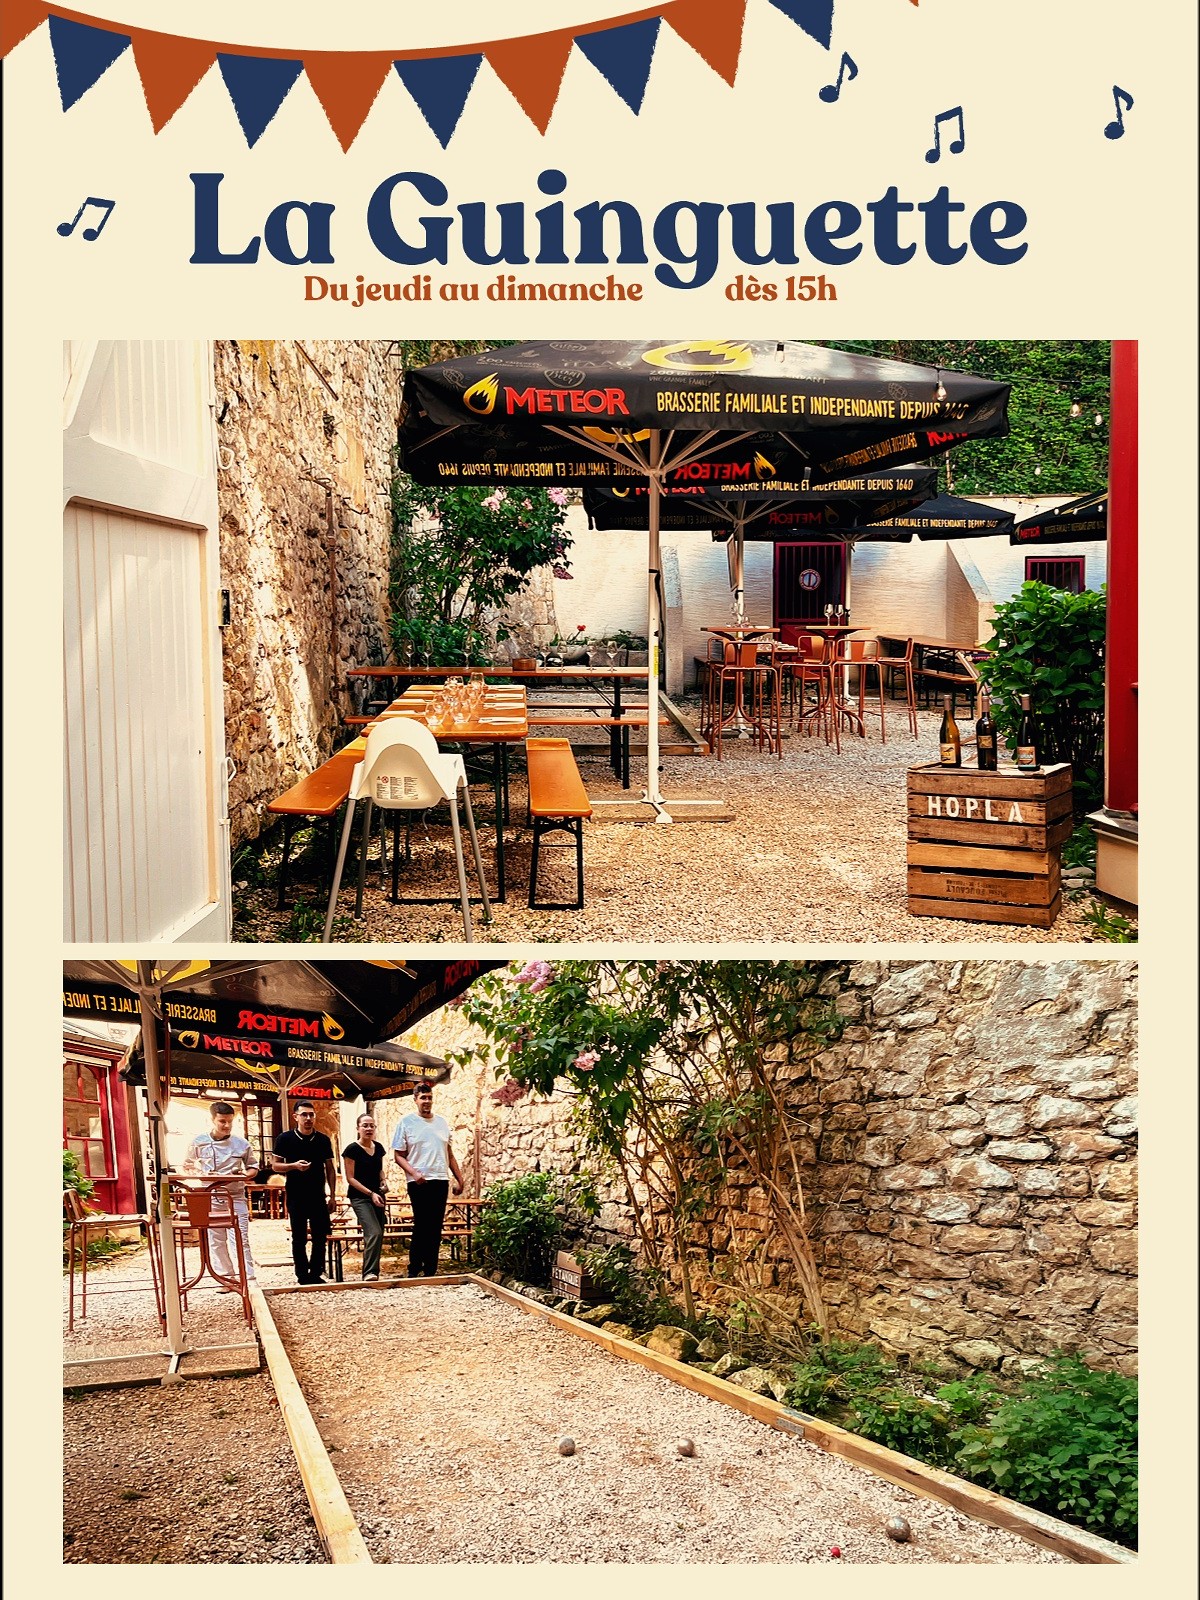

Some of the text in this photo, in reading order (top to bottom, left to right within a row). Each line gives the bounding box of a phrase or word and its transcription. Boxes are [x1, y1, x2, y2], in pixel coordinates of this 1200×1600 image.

[503, 386, 630, 415] METEOR
[656, 391, 721, 413] BRASSERIE
[725, 392, 788, 414] FAMILIALE
[791, 395, 806, 414] ET
[810, 396, 896, 419] INDEPENDANTE
[900, 400, 941, 420] DEPUIS
[762, 480, 799, 492] FAMILIALE
[801, 479, 810, 491] ET
[867, 479, 894, 491] DEPUIS
[896, 479, 914, 491] 1640
[927, 796, 1023, 823] HOPLA
[203, 1034, 274, 1058] METEOR
[287, 1047, 322, 1062] BRASSERIE
[356, 1056, 363, 1067] ET
